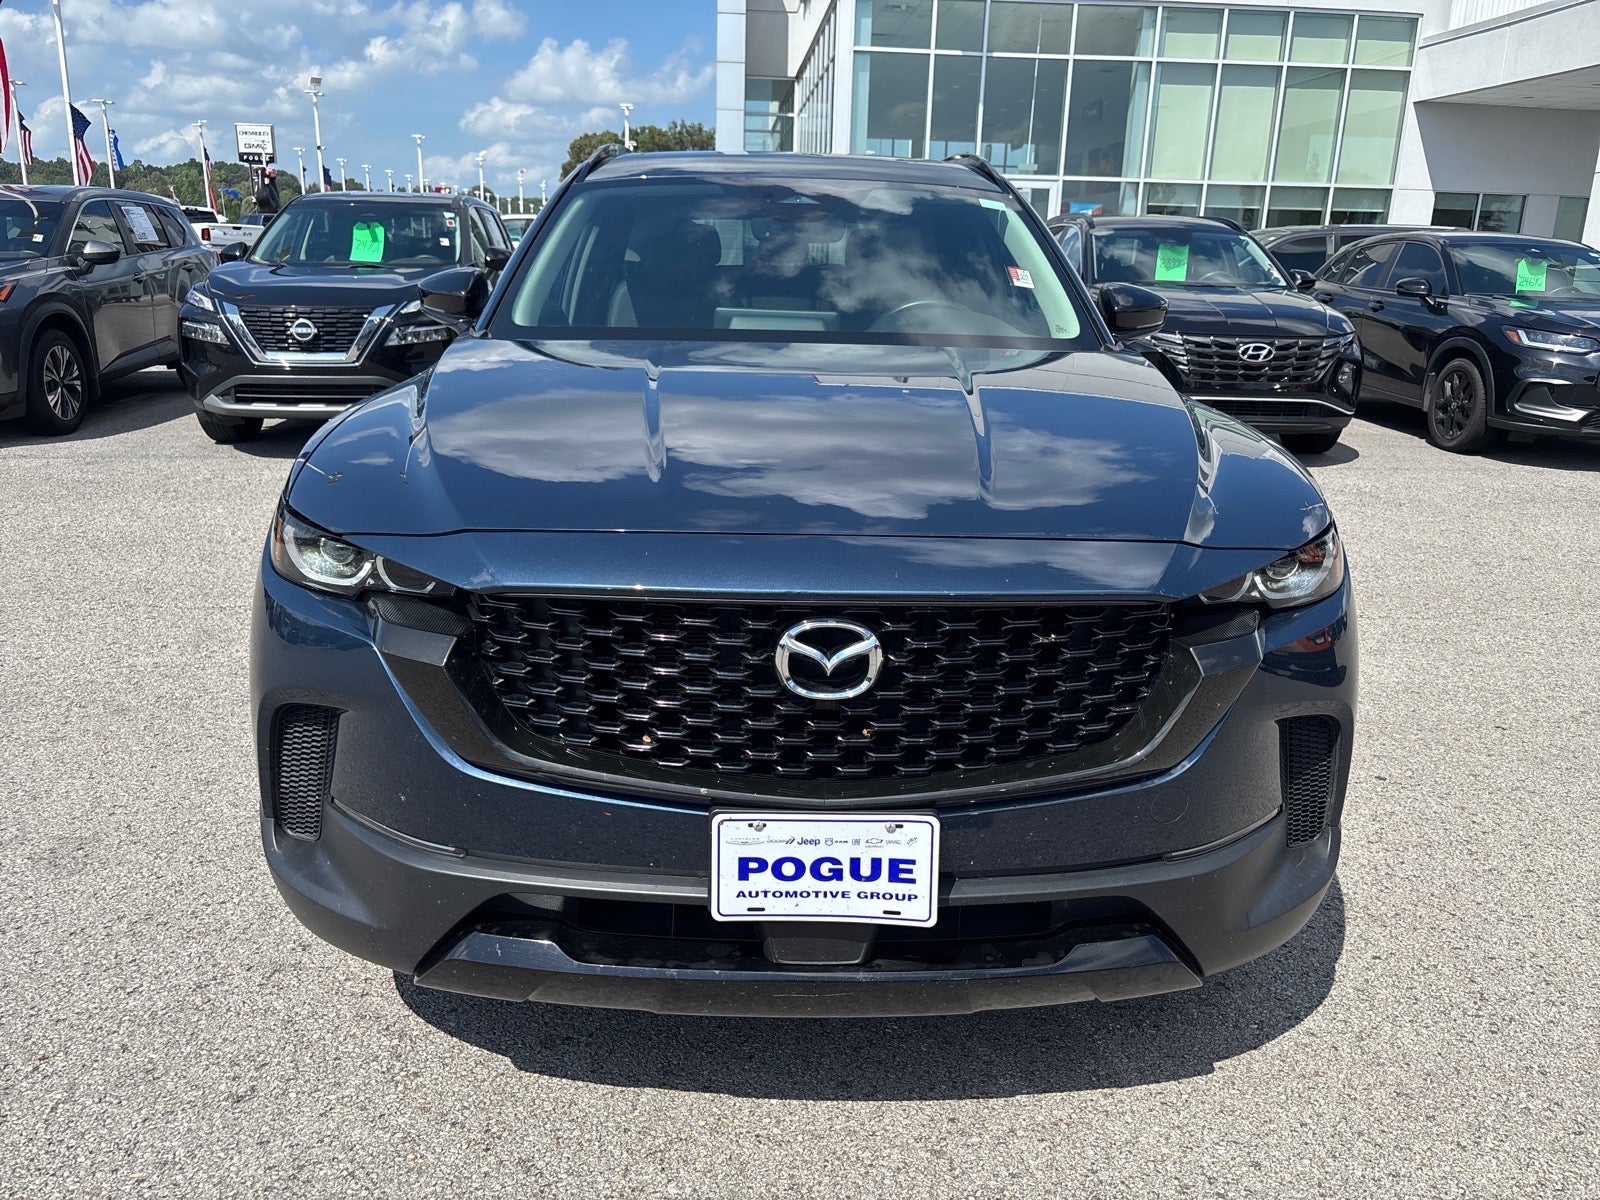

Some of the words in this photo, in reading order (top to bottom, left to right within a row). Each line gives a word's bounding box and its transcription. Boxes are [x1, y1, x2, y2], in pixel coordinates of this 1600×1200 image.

[796, 837, 821, 846] Jeep
[737, 856, 917, 885] POGUE
[735, 890, 852, 900] AUTOMOTIVE
[856, 891, 919, 902] GROUP
